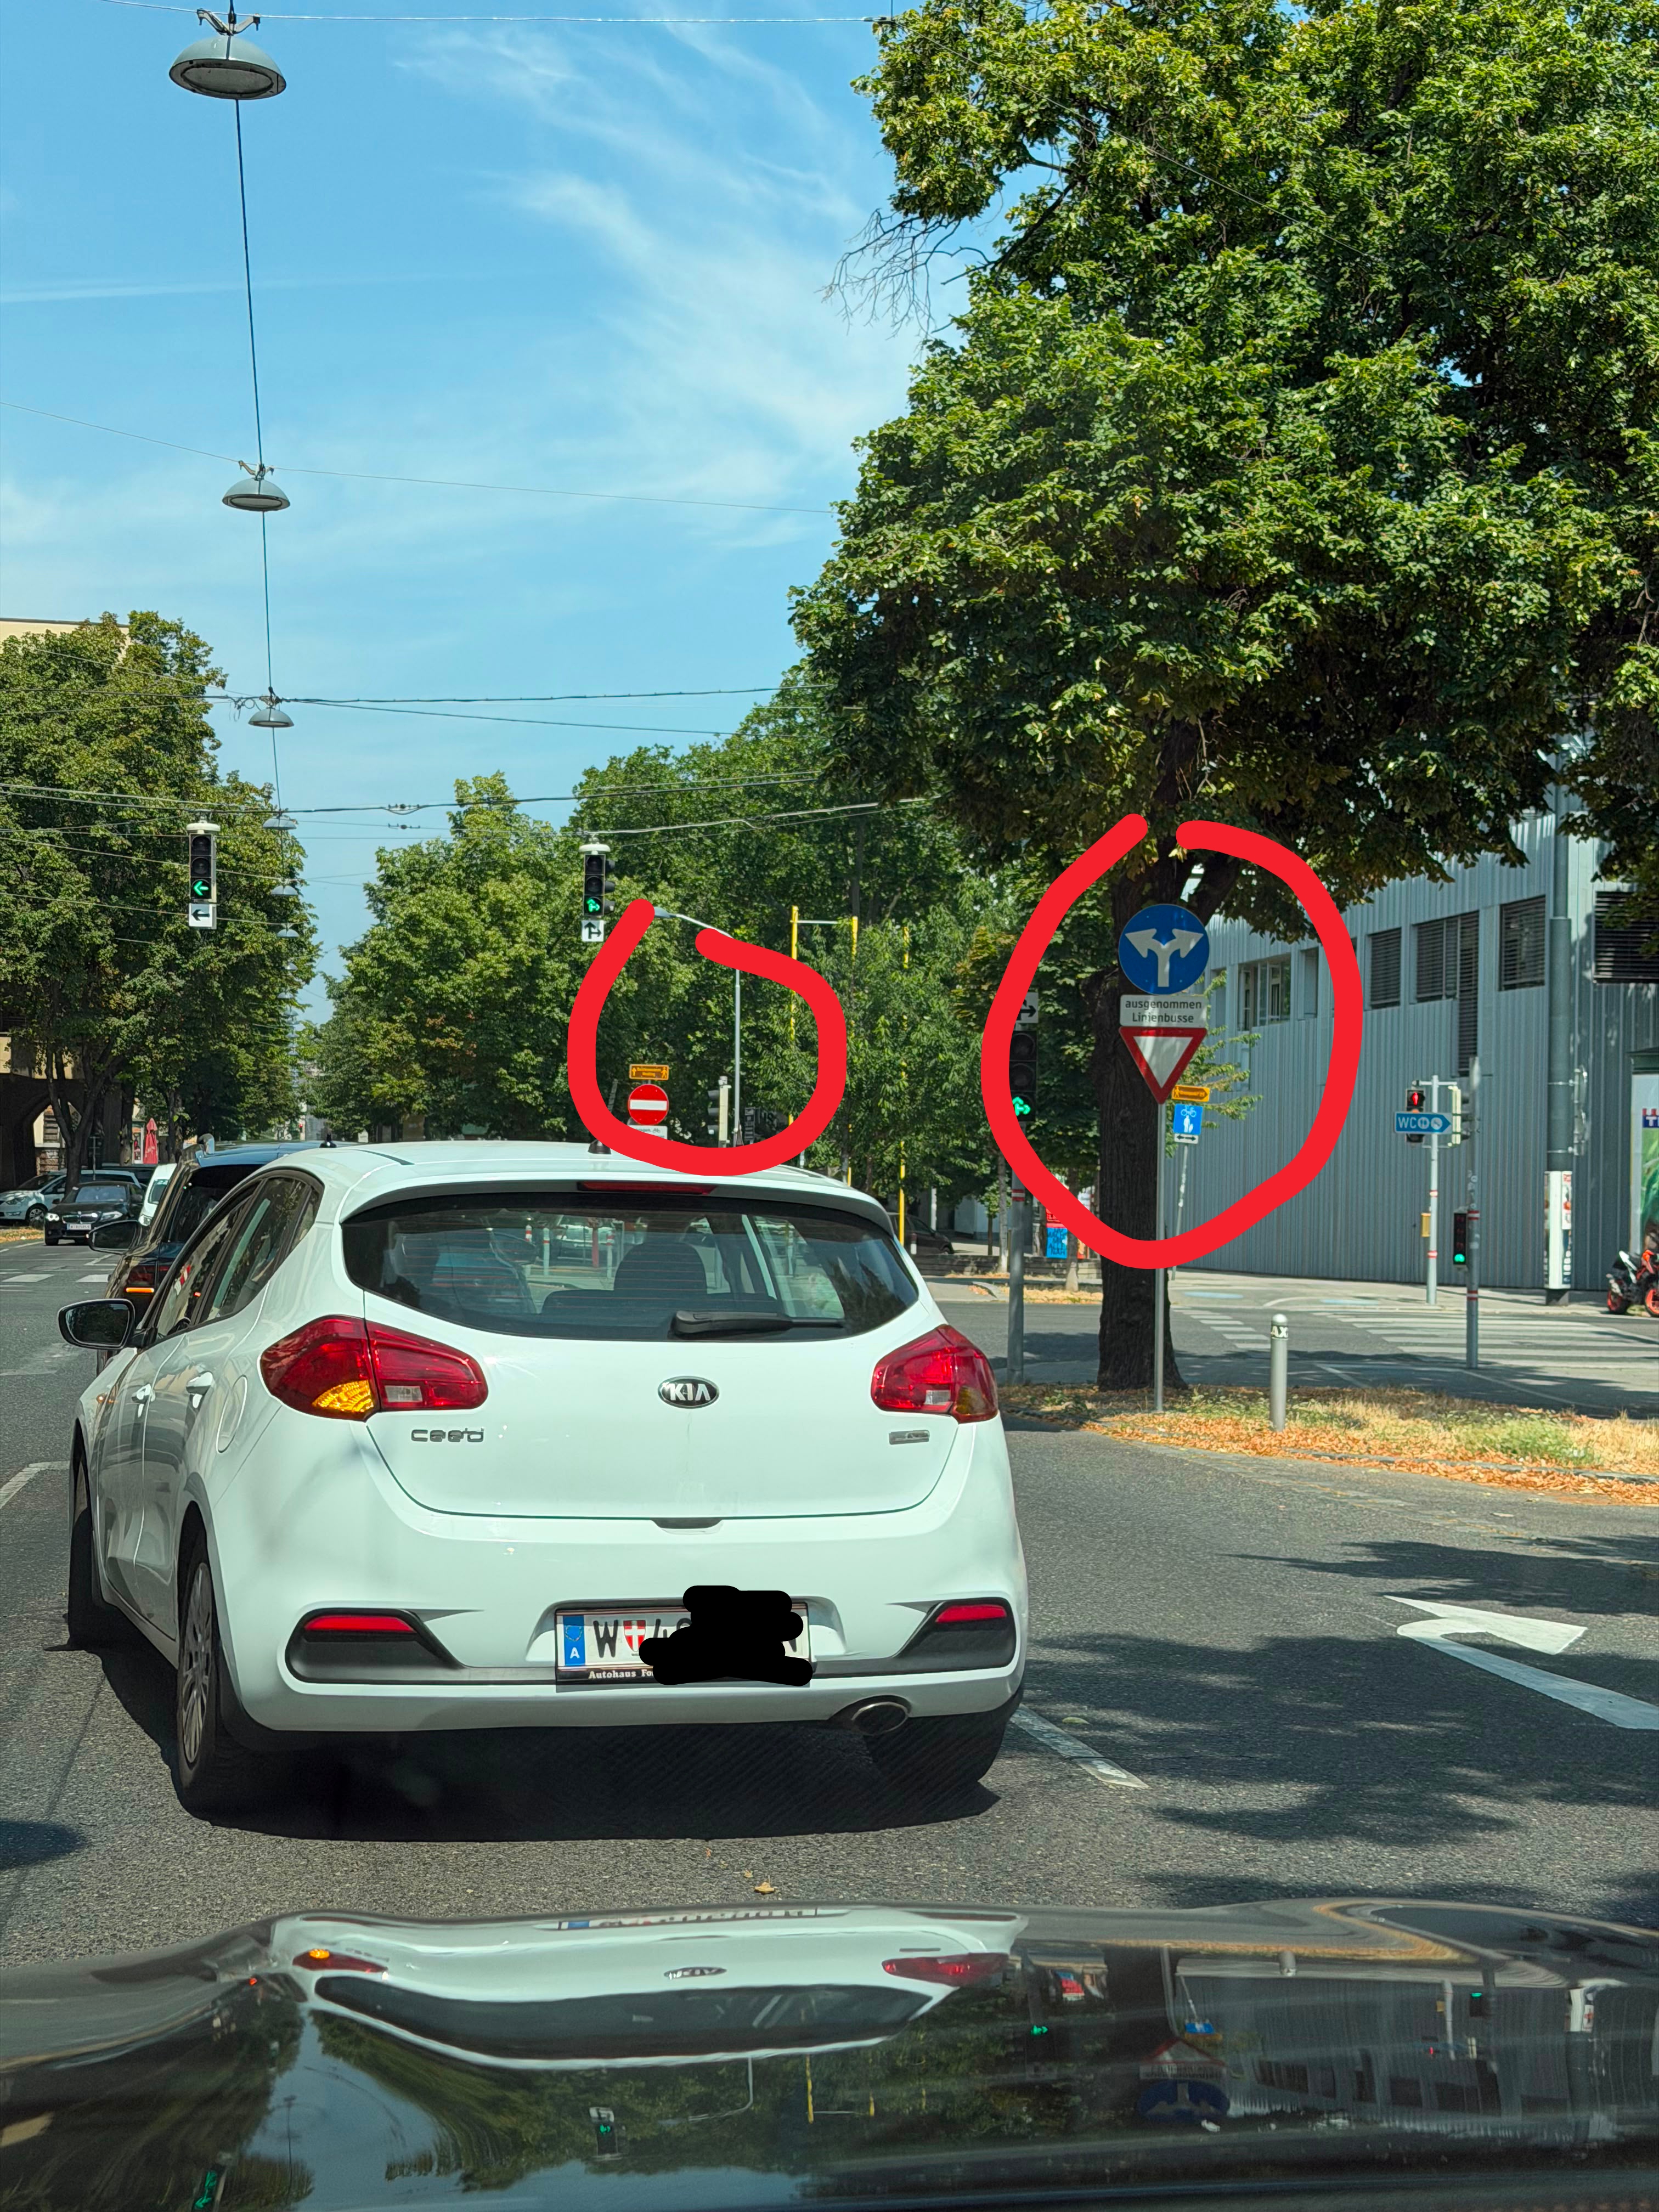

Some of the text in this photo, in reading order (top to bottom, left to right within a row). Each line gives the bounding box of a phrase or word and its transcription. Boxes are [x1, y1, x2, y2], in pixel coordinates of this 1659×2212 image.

[1125, 1001, 1202, 1011] ausgenommen
[1132, 1012, 1194, 1023] Linienbusse
[1398, 1116, 1417, 1128] WC
[669, 1383, 712, 1401] KIA
[569, 1647, 580, 1659] A
[588, 1670, 636, 1679] Autohaus
